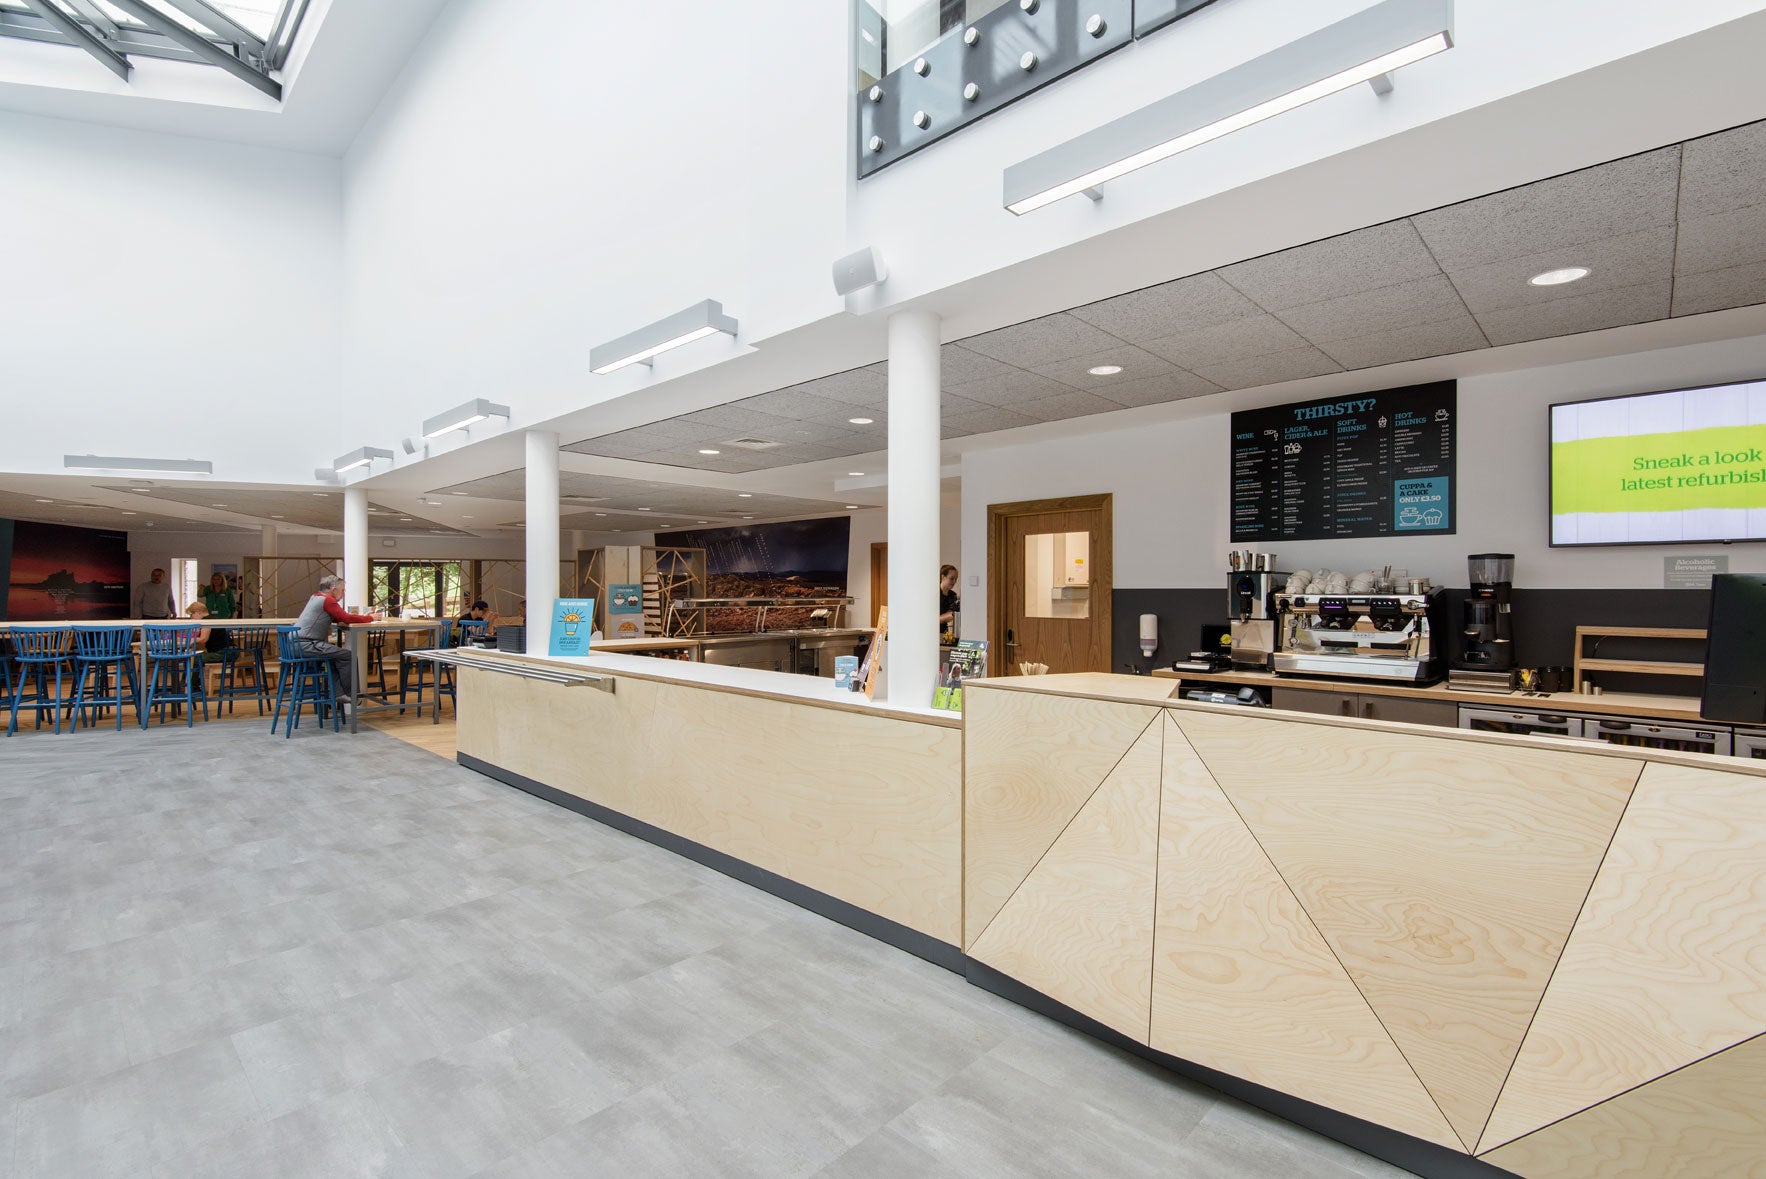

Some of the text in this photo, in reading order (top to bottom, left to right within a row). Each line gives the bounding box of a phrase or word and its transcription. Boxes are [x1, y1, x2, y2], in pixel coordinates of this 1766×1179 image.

[1295, 399, 1376, 421] THIRSTY?
[1395, 417, 1427, 426] DRINKS
[1285, 432, 1306, 440] CIDER
[1313, 429, 1328, 437] ALE
[1337, 424, 1367, 433] DRINKS
[1633, 449, 1763, 470] Sneak a look
[1622, 476, 1673, 491] latest
